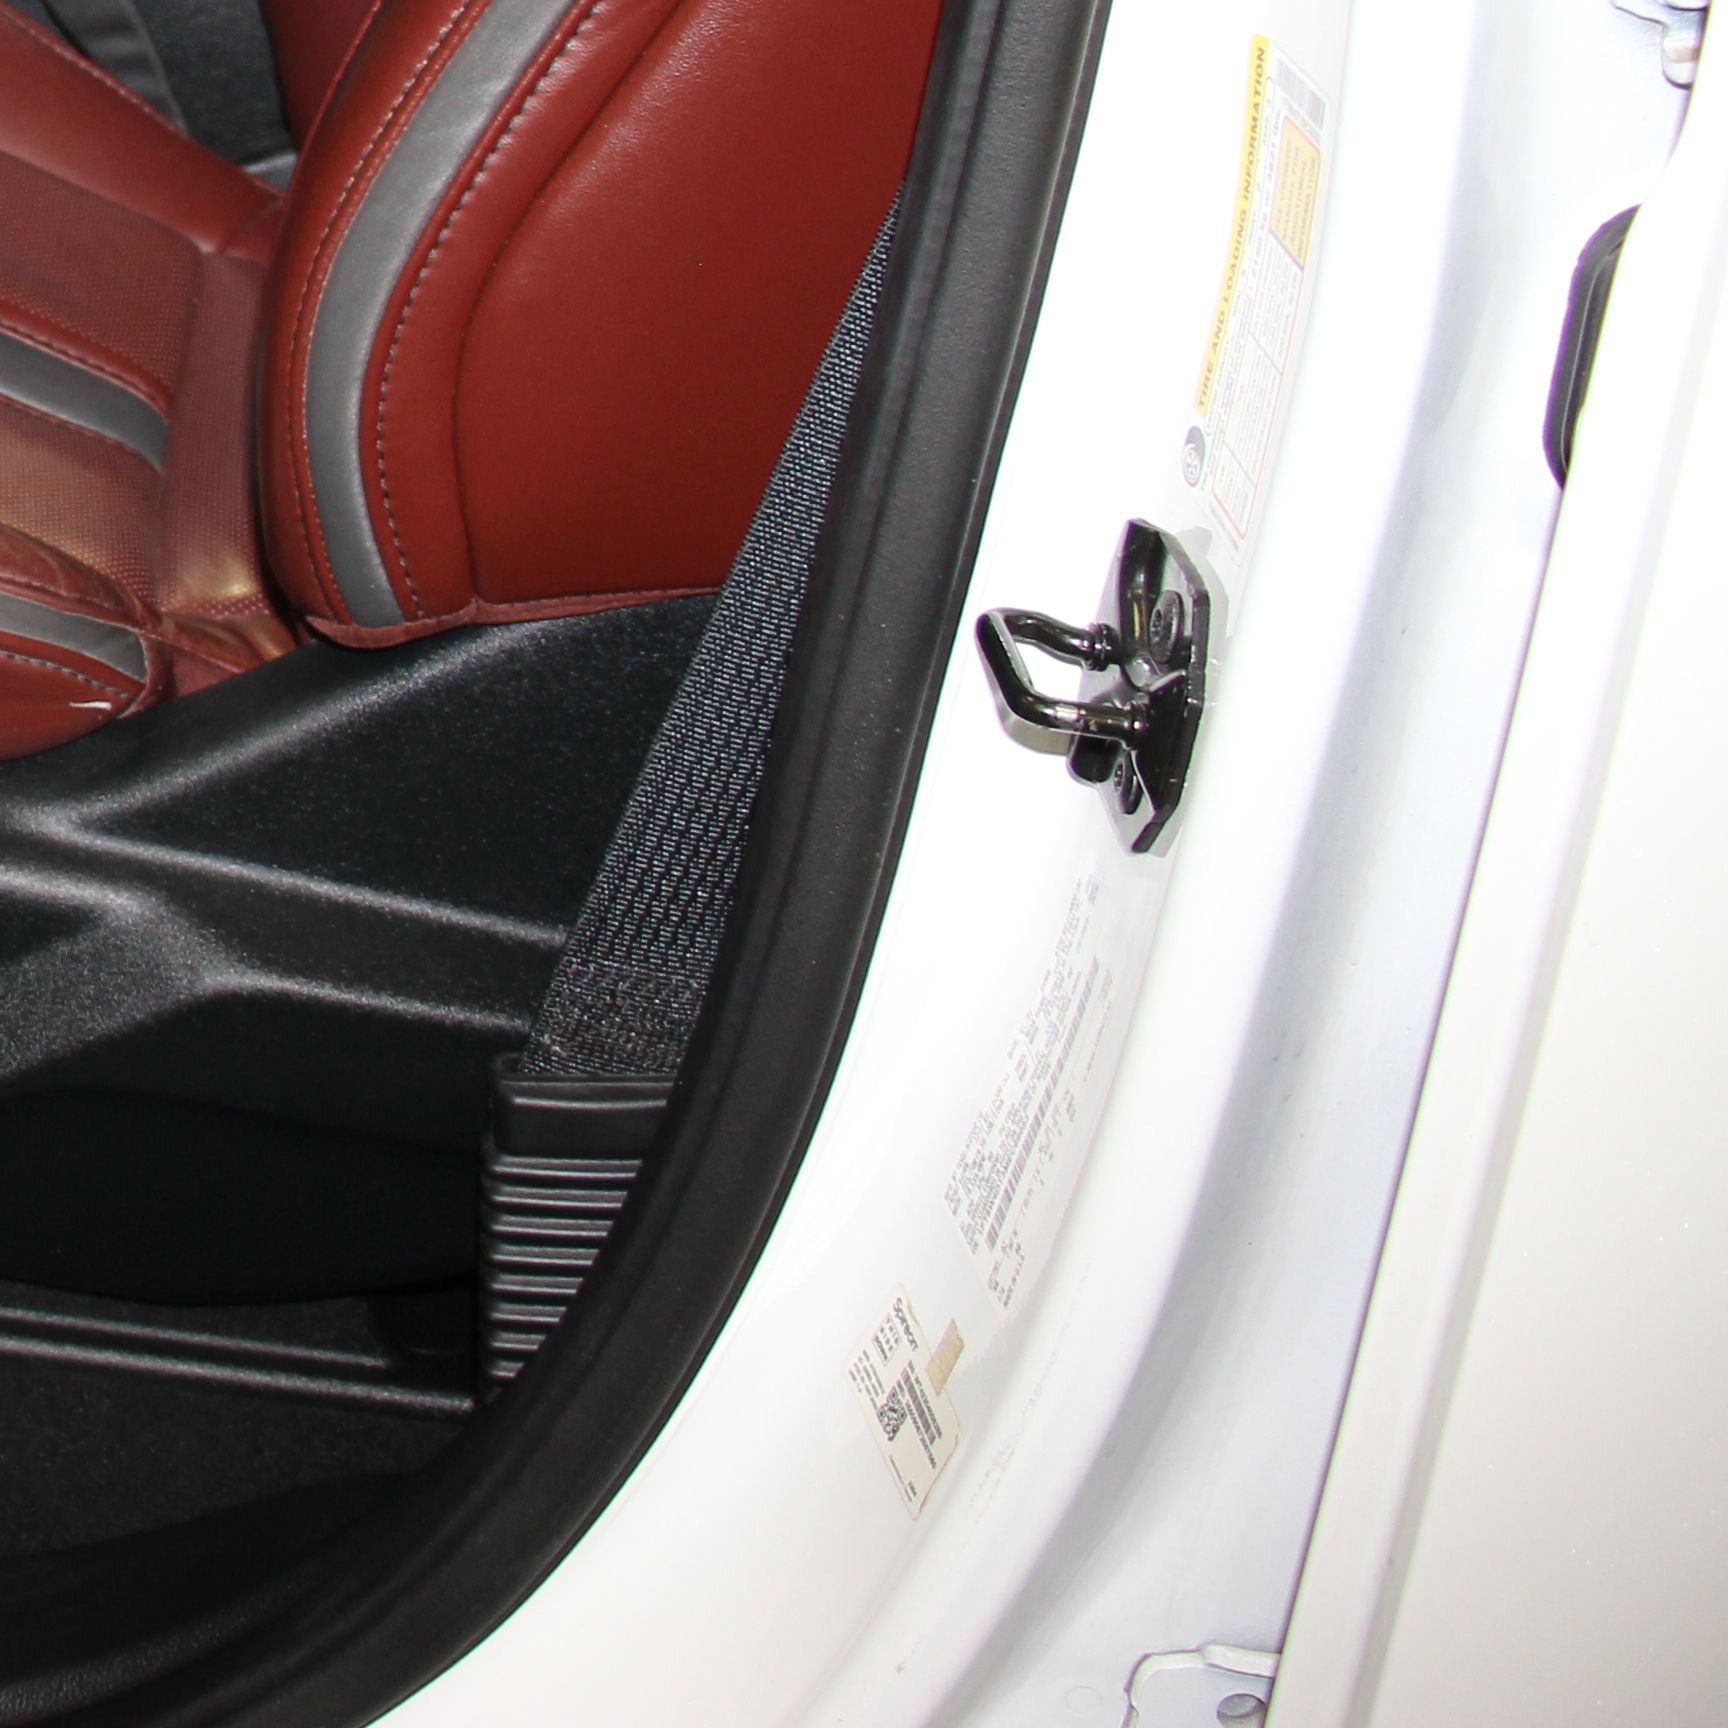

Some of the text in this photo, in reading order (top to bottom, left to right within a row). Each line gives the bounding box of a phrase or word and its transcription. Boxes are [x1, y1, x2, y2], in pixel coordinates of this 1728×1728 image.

[1198, 361, 1214, 407] TIRE
[1212, 309, 1226, 356] AND
[1223, 207, 1248, 305] LOADING
[1242, 46, 1266, 202] INFORMATION
